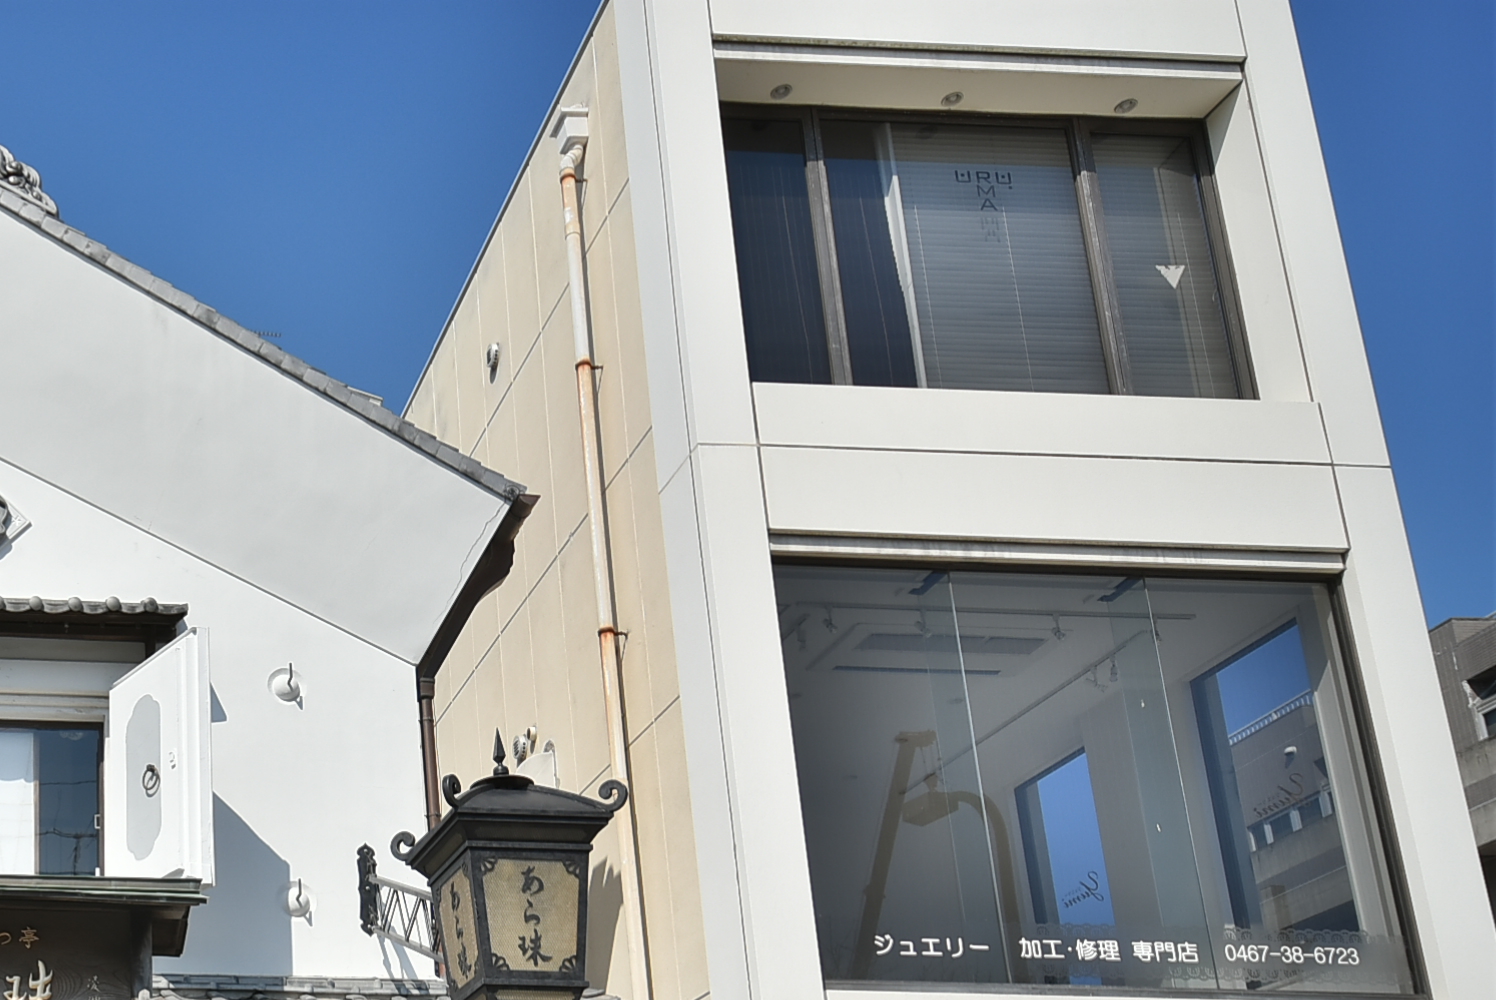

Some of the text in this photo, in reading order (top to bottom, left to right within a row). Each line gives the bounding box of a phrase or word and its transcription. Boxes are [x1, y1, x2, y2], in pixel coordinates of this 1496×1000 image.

[873, 933, 1360, 967] ジュエリー 加工・修理 専門店 0467-38-6723
